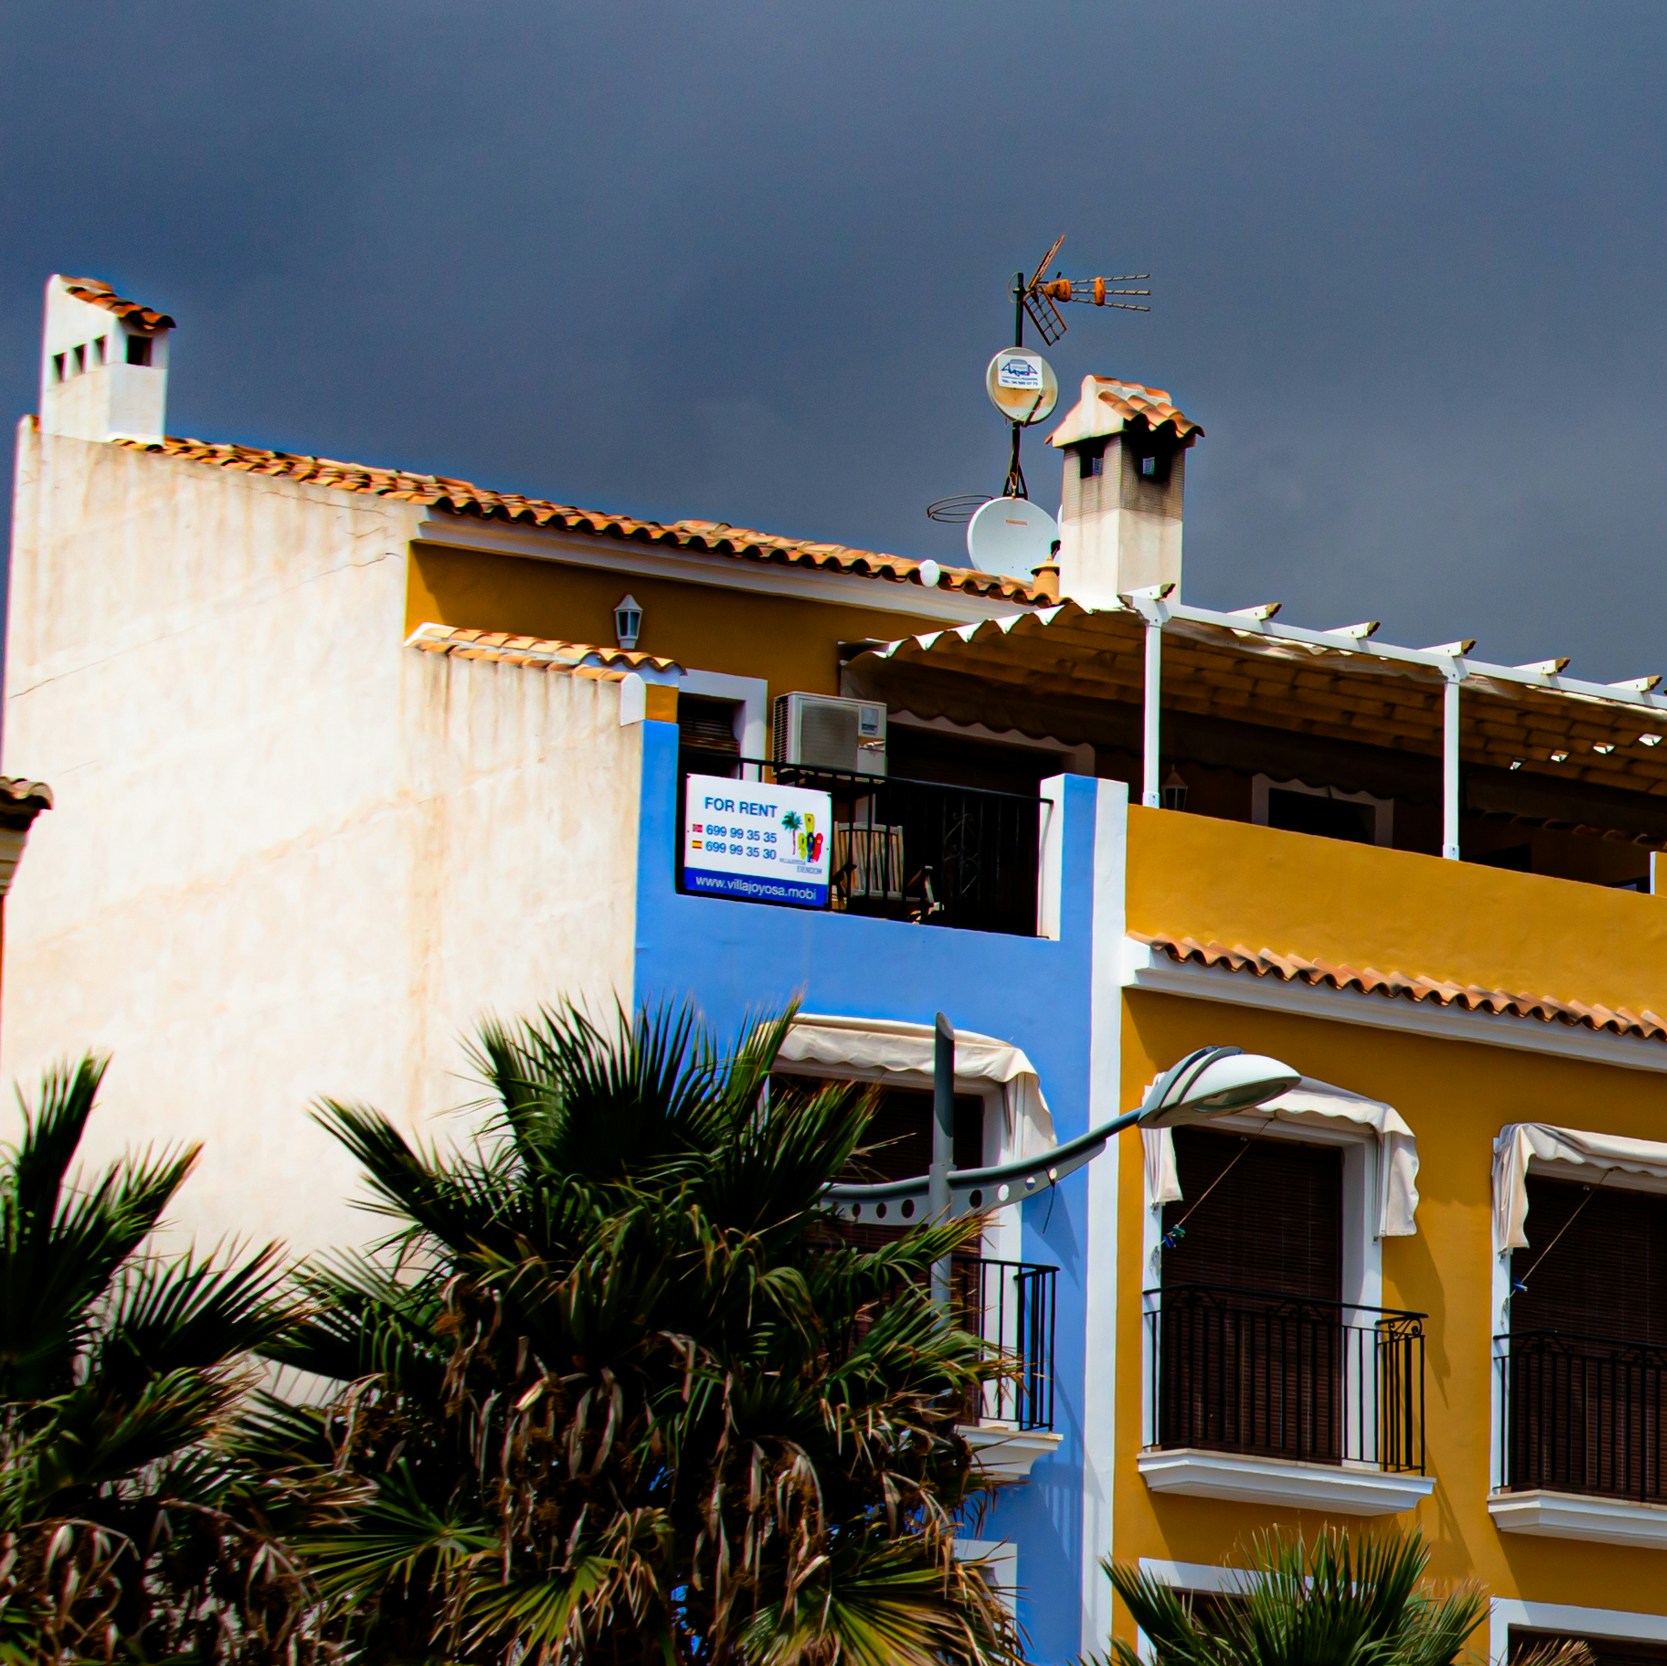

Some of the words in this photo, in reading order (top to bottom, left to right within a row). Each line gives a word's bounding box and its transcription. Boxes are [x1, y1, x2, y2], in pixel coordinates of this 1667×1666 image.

[704, 796, 735, 813] FOR
[739, 801, 778, 818] RENT
[706, 824, 727, 837] 699
[730, 827, 744, 839] 99
[746, 829, 761, 842] 35
[763, 831, 777, 844] 35
[705, 841, 726, 854] 699
[729, 843, 744, 856] 99
[746, 846, 760, 858] 35
[763, 848, 777, 860] 30
[695, 875, 817, 900] www.villajoyosa.mobi
